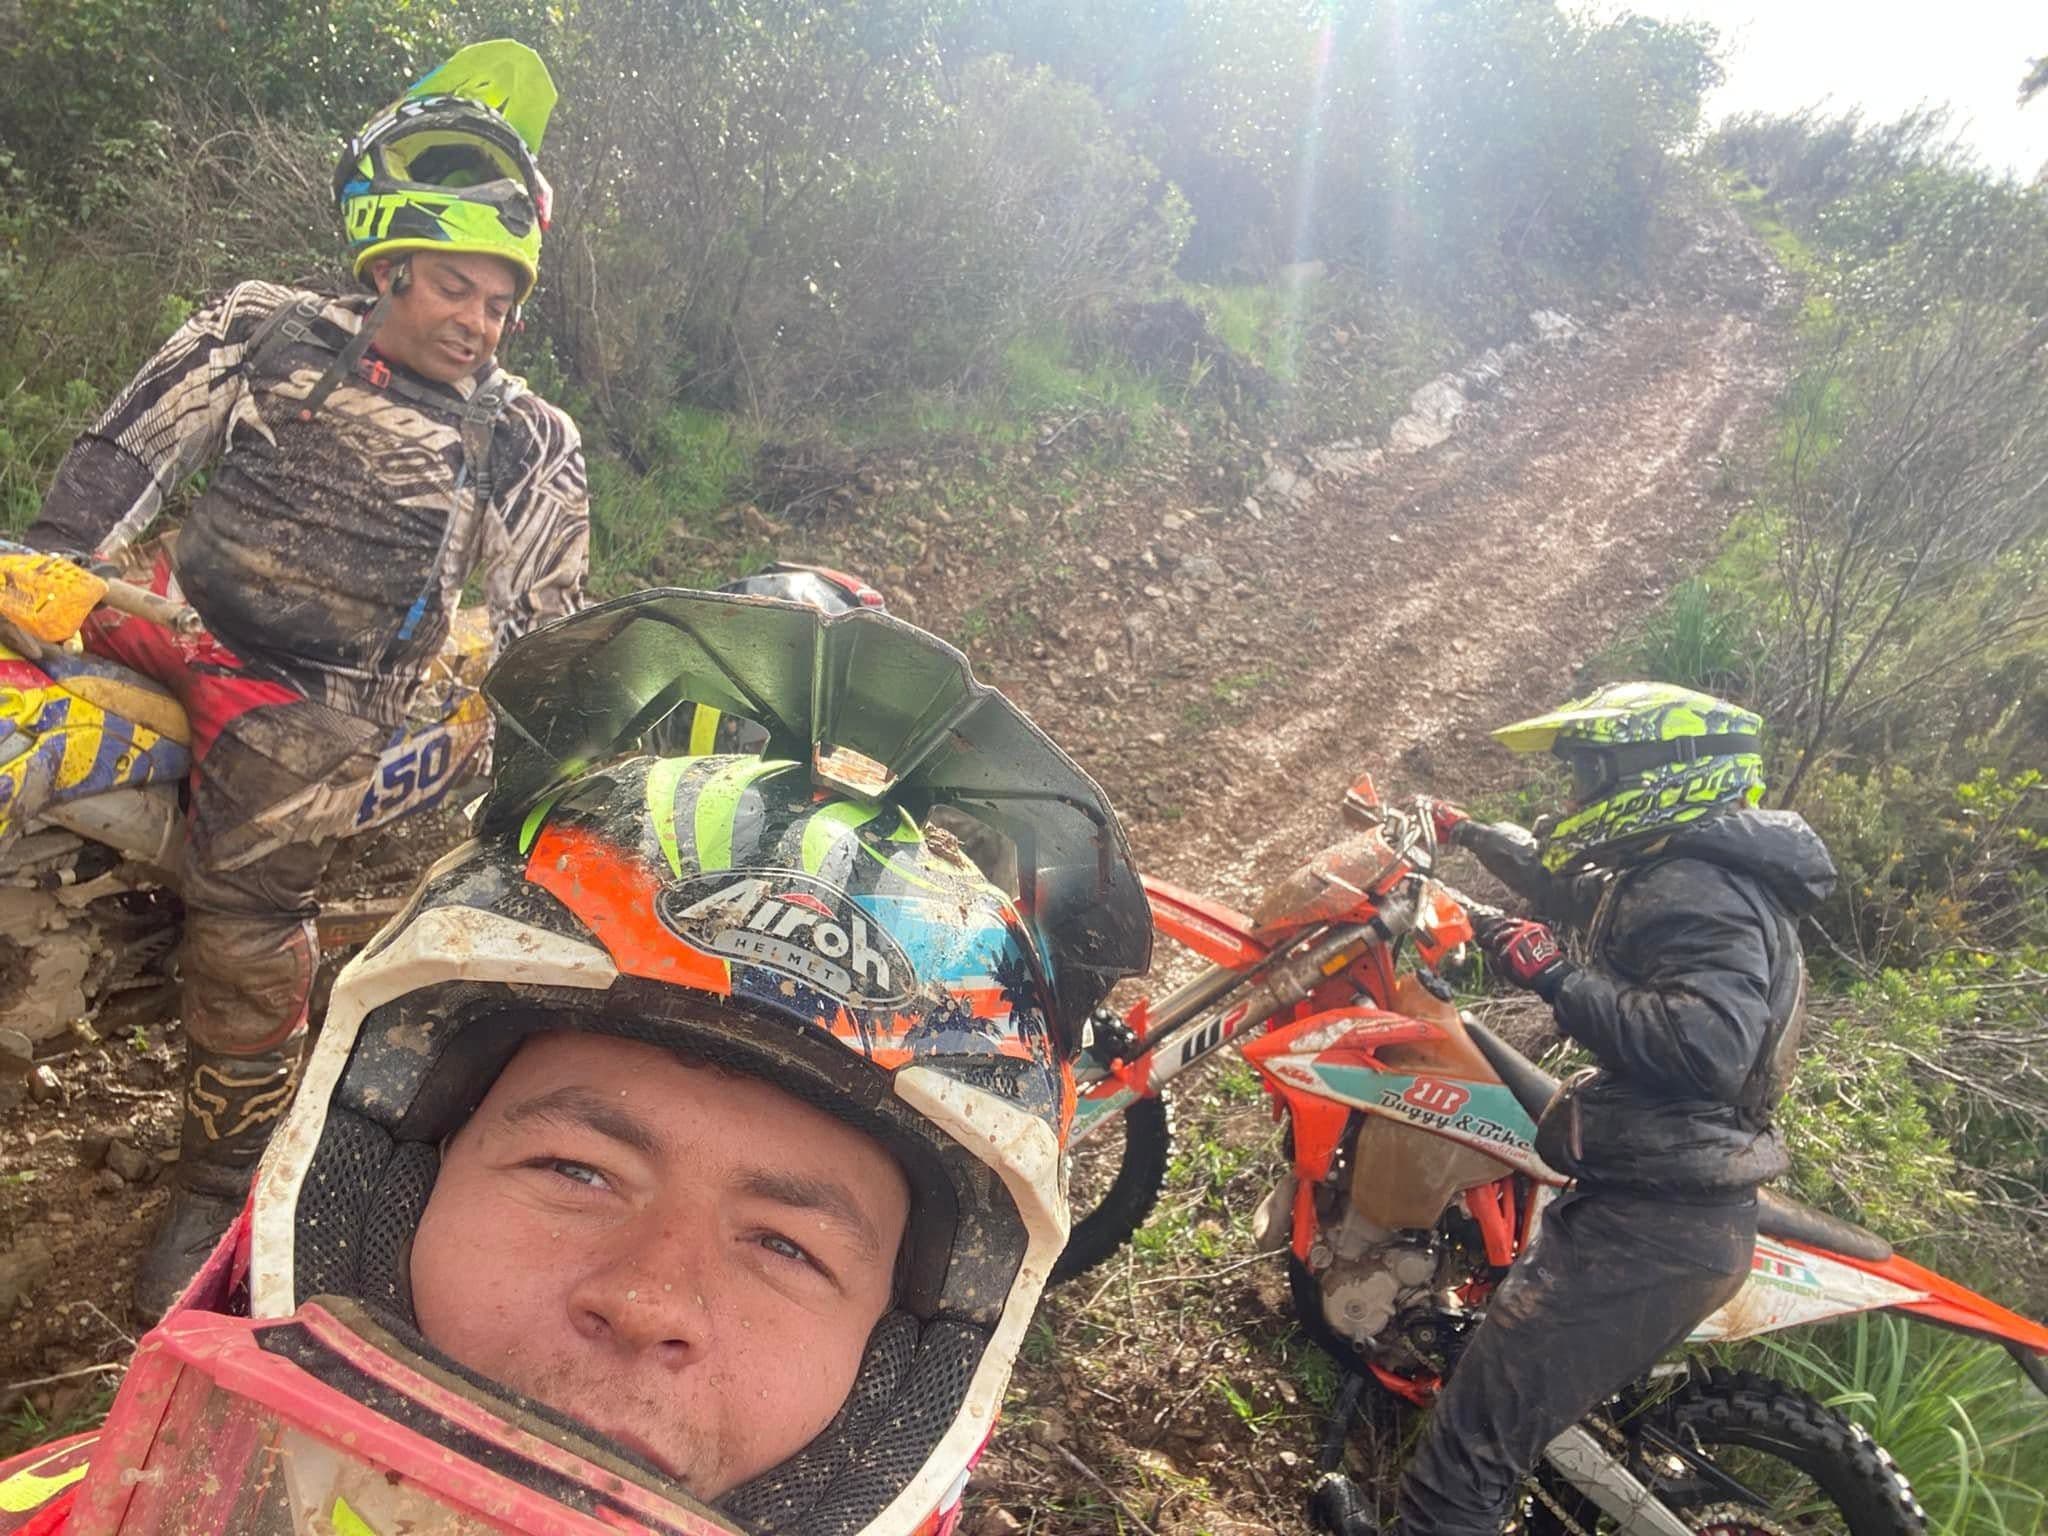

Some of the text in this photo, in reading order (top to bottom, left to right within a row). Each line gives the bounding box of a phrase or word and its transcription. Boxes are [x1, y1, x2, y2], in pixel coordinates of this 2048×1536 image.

[676, 878, 890, 992] Airoh
[734, 937, 836, 980] HELMET
[1379, 1089, 1534, 1150] Buggy & Bike
